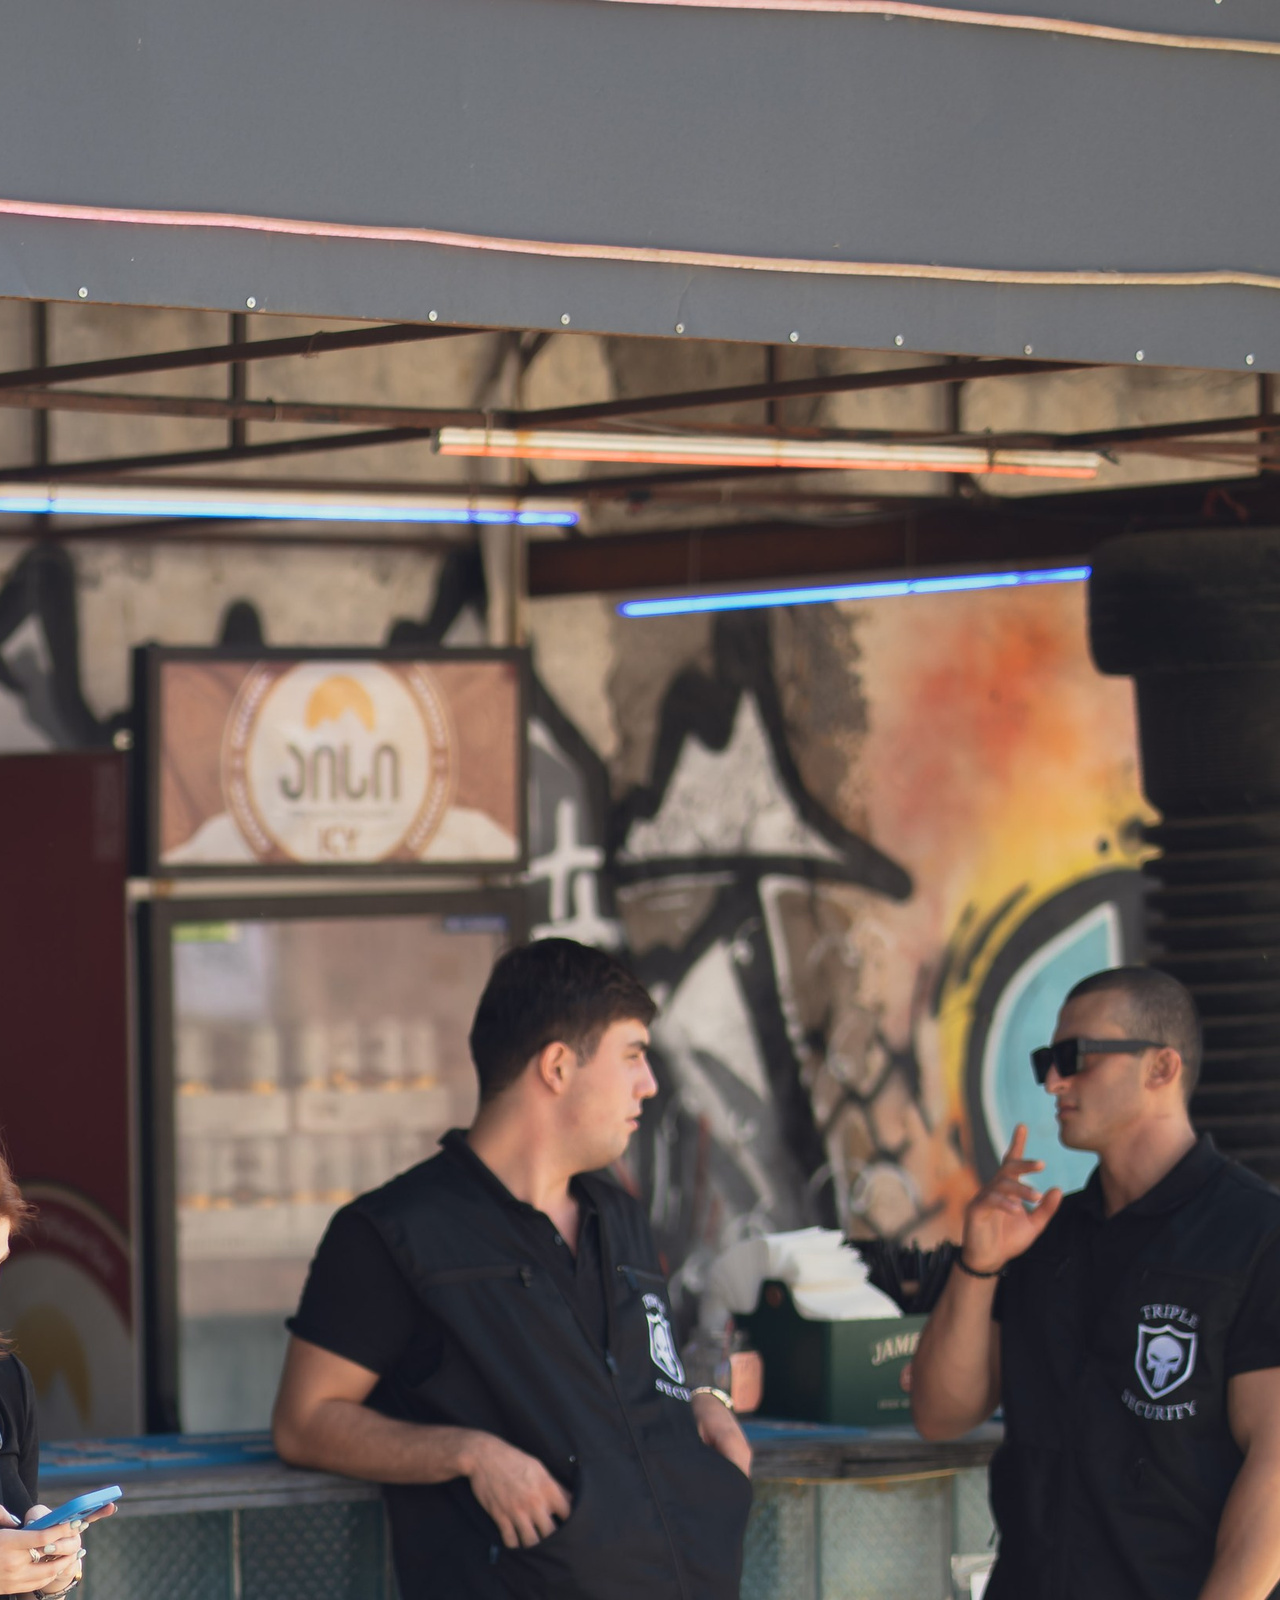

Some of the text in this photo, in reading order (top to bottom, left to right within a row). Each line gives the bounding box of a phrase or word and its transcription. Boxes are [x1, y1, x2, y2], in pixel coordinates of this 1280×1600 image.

[1140, 1303, 1200, 1329] TRIPLE
[655, 1378, 692, 1402] SECU
[1121, 1388, 1197, 1421] SECURITY
